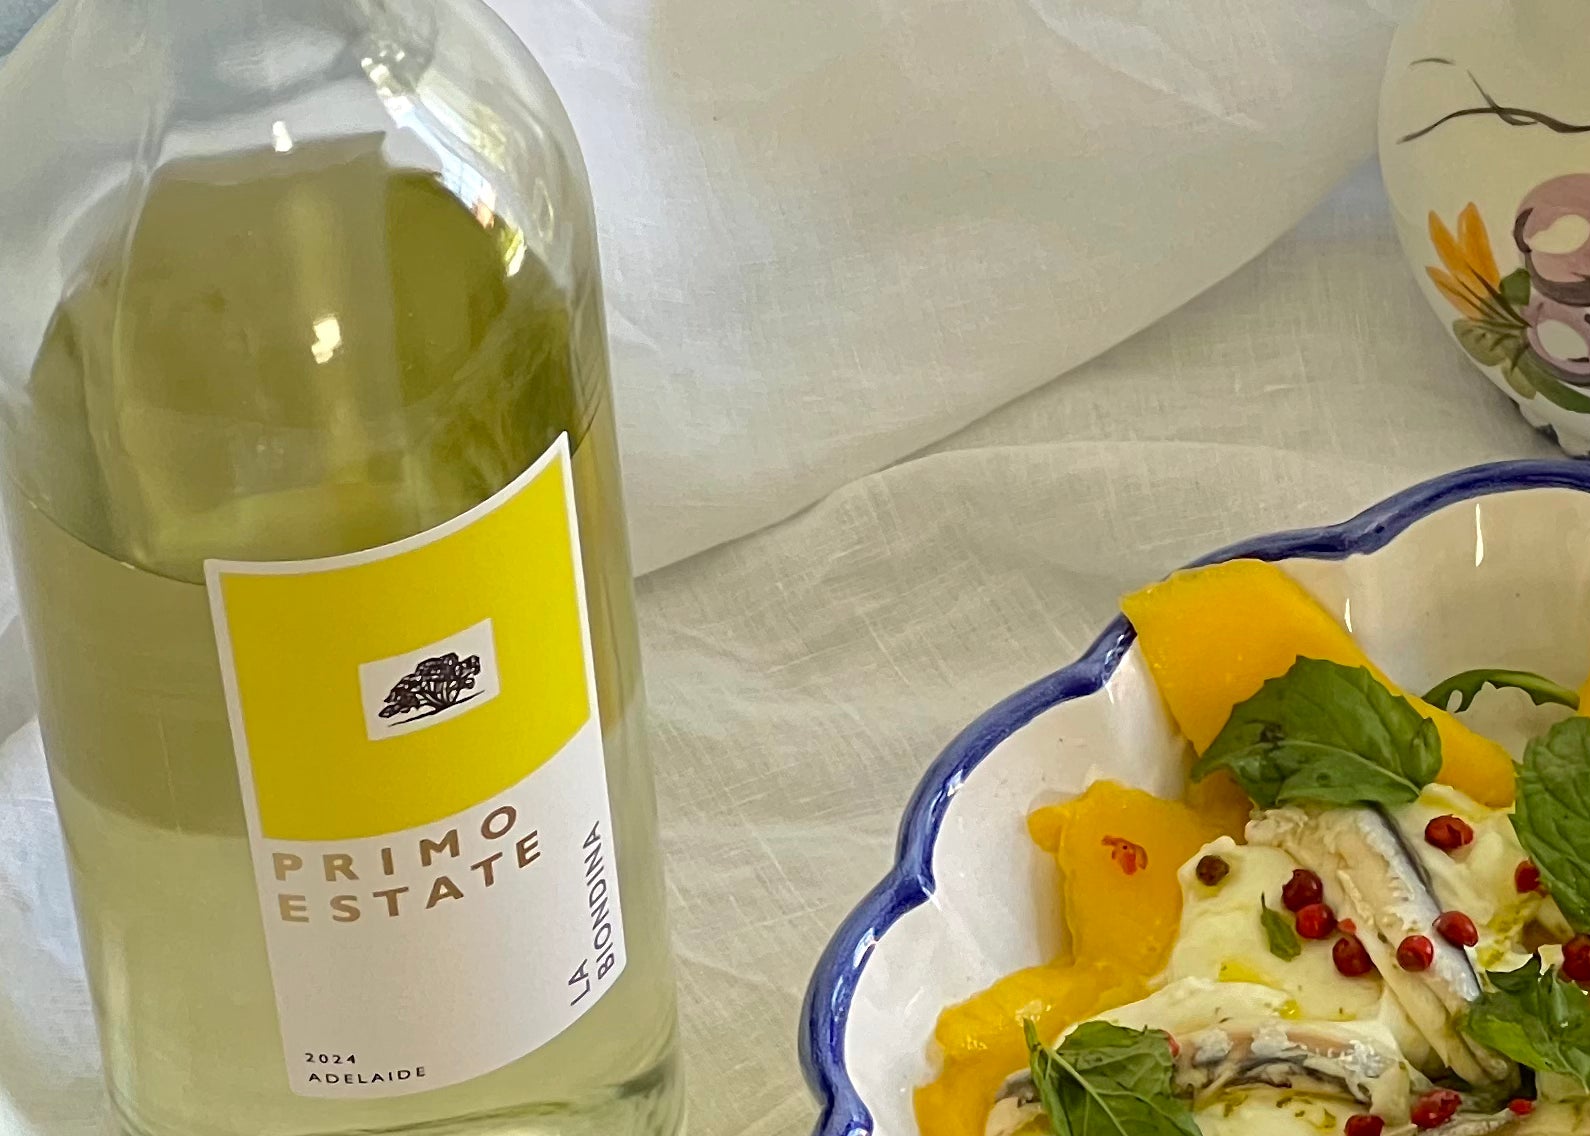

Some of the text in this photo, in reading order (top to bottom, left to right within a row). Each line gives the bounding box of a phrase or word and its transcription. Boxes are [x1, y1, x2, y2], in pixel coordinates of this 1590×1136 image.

[272, 805, 518, 882] PRIMO
[278, 830, 541, 923] ESTATE
[582, 820, 615, 980] BIONDINA
[567, 959, 591, 1006] LA
[305, 1053, 356, 1065] 2024
[308, 1066, 426, 1085] ADELAIDE
